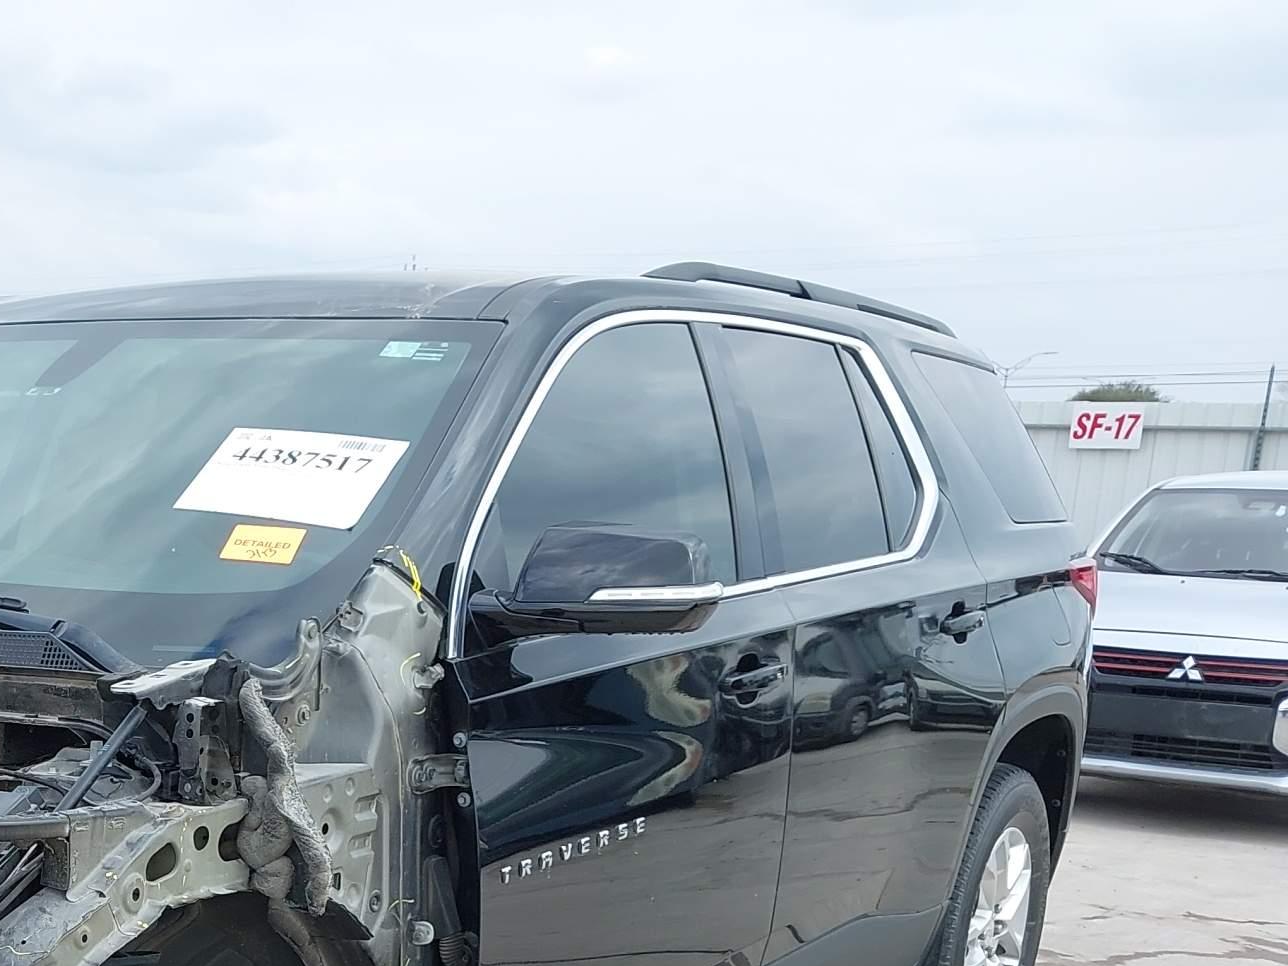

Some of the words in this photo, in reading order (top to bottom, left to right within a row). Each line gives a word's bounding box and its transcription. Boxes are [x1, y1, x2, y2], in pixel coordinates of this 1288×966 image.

[1072, 412, 1142, 440] SF-17
[232, 447, 374, 474] 44387517
[233, 538, 291, 551] DETAILED
[500, 816, 646, 885] TRAVERSE
